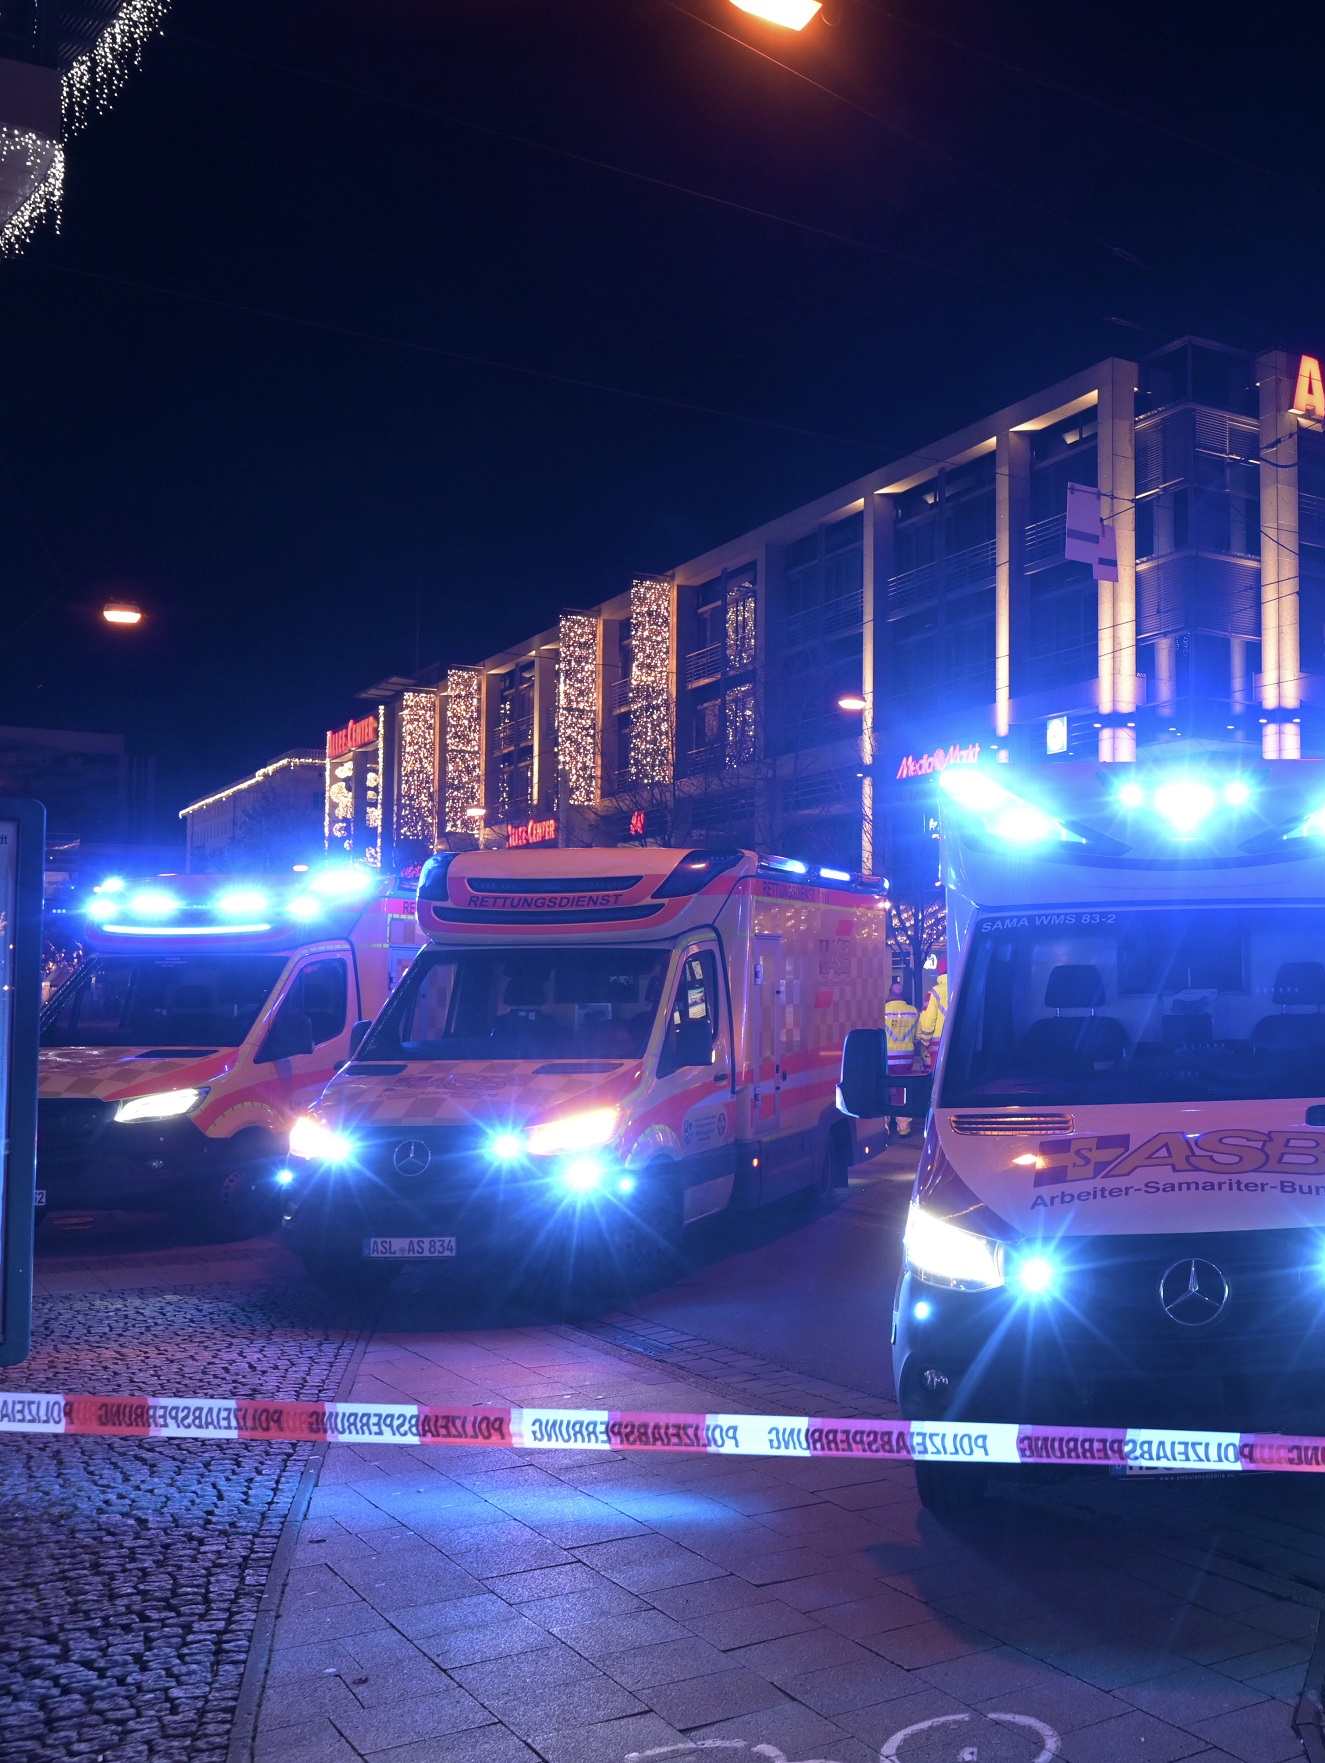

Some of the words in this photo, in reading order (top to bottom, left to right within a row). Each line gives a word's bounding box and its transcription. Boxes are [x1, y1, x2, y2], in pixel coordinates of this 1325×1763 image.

[467, 893, 623, 909] RETTUNGSDIENST
[981, 917, 1029, 933] SAMA
[1035, 914, 1076, 926] WMS
[1081, 913, 1117, 925] 83-2
[371, 1239, 397, 1255] ASL
[407, 1239, 425, 1255] AS
[428, 1239, 455, 1254] 834
